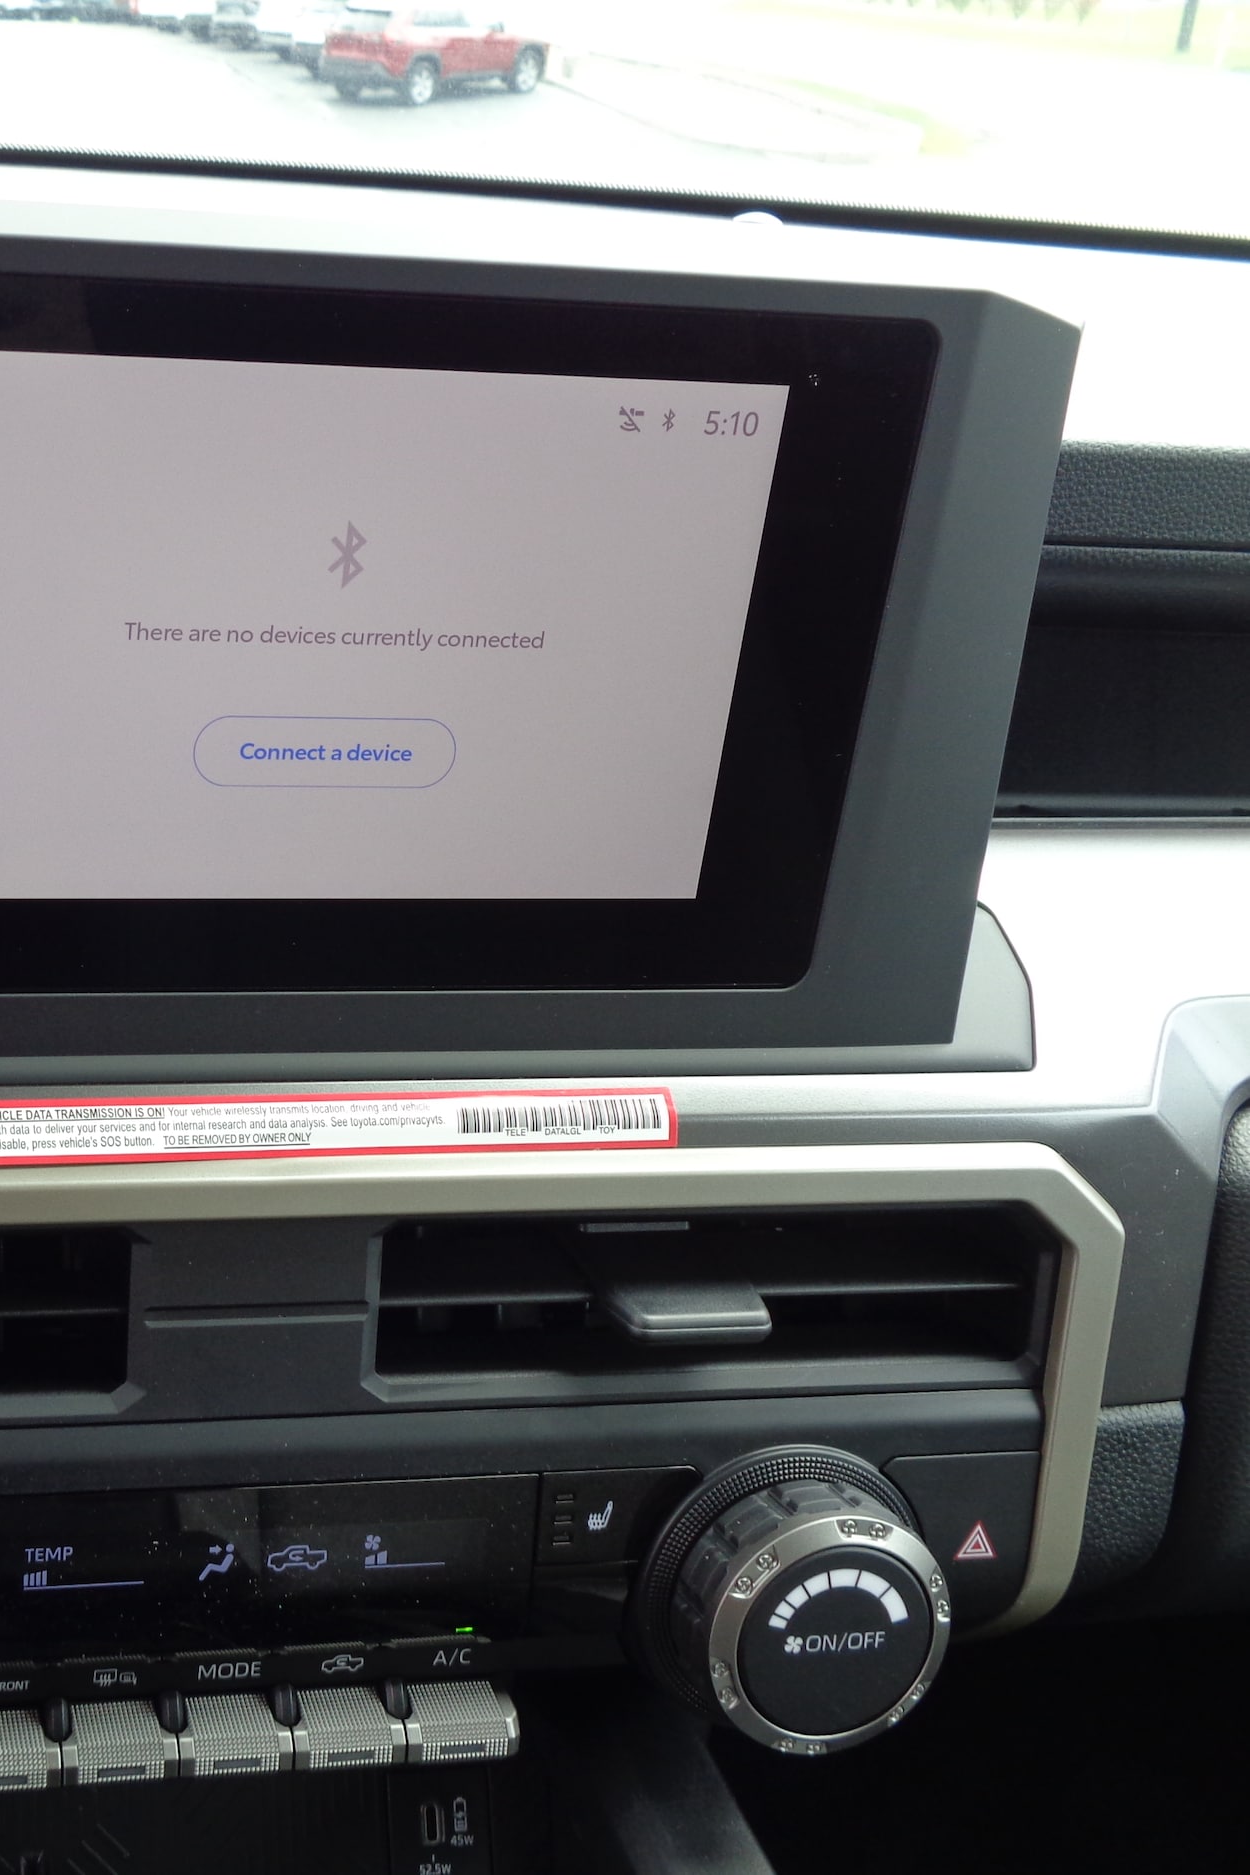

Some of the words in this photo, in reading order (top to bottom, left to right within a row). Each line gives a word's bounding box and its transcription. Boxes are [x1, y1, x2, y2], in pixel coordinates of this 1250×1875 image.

[703, 410, 760, 437] 5:10
[124, 622, 183, 642] There
[188, 626, 222, 643] are
[226, 627, 254, 643] no
[259, 625, 336, 645] devices
[340, 627, 434, 651] currently
[437, 630, 546, 649] connected
[239, 742, 327, 761] Connect
[330, 747, 343, 761] a
[346, 743, 413, 762] device
[25, 1109, 53, 1121] DATA
[55, 1108, 132, 1120] TRANSMISSION
[135, 1107, 145, 1118] IS
[147, 1107, 165, 1118] ON!
[168, 1106, 188, 1117] Your
[190, 1106, 222, 1116] vehicle
[225, 1105, 267, 1117] wirelessly
[269, 1104, 309, 1115] transmits
[350, 1103, 379, 1114] driving
[381, 1102, 398, 1112] and
[10, 1124, 30, 1135] data
[33, 1124, 42, 1134] to
[45, 1122, 74, 1134] deliver
[77, 1124, 97, 1136] your
[99, 1122, 136, 1133] services
[139, 1121, 156, 1132] and
[158, 1120, 170, 1132] for
[172, 1120, 206, 1131] internal
[208, 1119, 247, 1130] research
[249, 1118, 266, 1129] and
[268, 1118, 288, 1129] data
[290, 1117, 328, 1130] analysis.
[330, 1116, 348, 1127] See
[350, 1115, 446, 1129] toyota.com/privacyvts.
[505, 1128, 526, 1137] TELE
[545, 1127, 581, 1136] DATALGL
[599, 1126, 616, 1134] TOY
[32, 1139, 57, 1151] press
[59, 1136, 98, 1148] vehicle's
[100, 1136, 122, 1147] SOS
[124, 1135, 155, 1147] button.
[164, 1135, 176, 1146] TO
[178, 1135, 190, 1145] BE
[192, 1134, 237, 1145] REMOVED
[239, 1133, 251, 1144] BY
[252, 1132, 286, 1144] OWNER
[288, 1132, 312, 1143] ONLY
[24, 1546, 74, 1564] TEMP
[805, 1631, 886, 1653] ON/OFF
[433, 1648, 472, 1668] A/C
[198, 1661, 262, 1680] MODE
[451, 1834, 474, 1846] 45W
[419, 1864, 451, 1875] 52.5W
